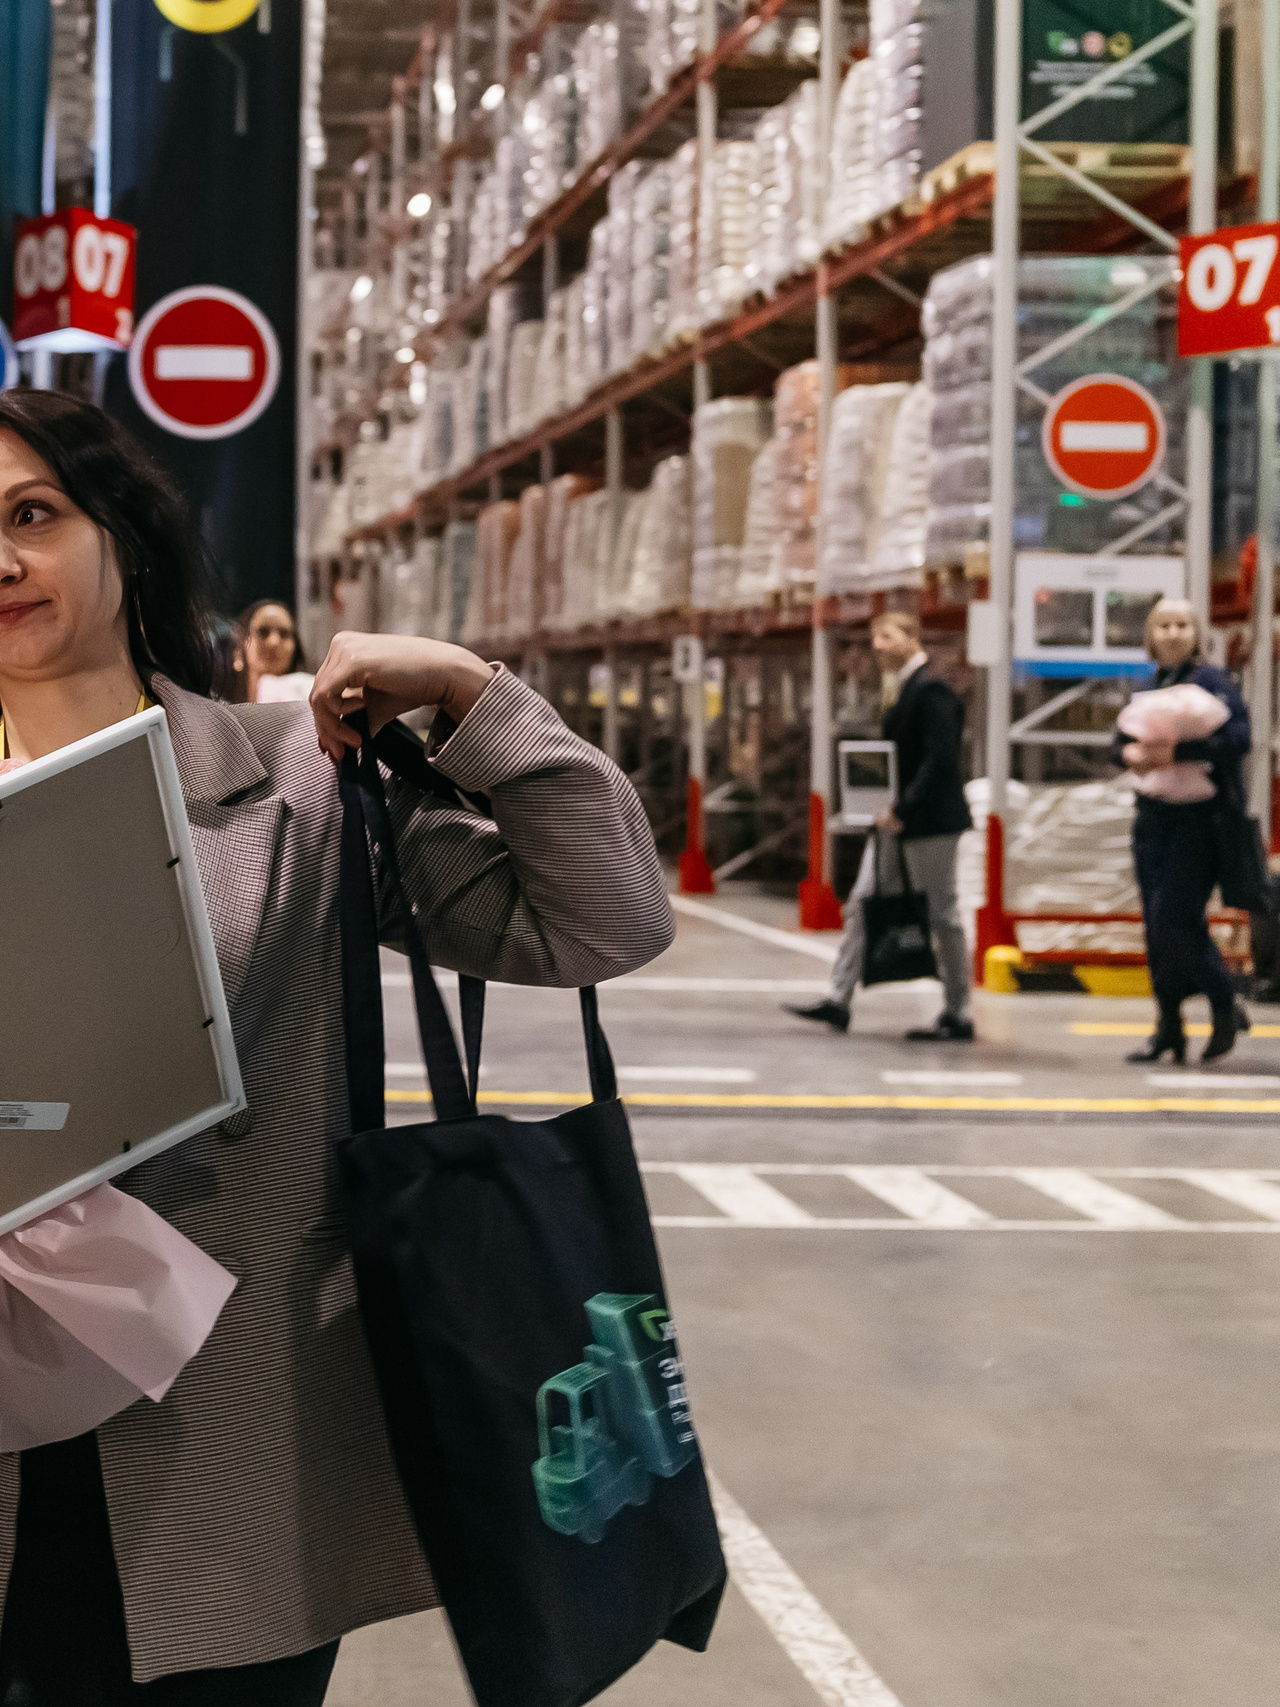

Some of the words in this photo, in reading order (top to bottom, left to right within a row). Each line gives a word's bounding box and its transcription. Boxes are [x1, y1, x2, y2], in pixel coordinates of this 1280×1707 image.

[15, 225, 68, 298] 08
[73, 224, 129, 298] 07
[1186, 234, 1278, 312] 07
